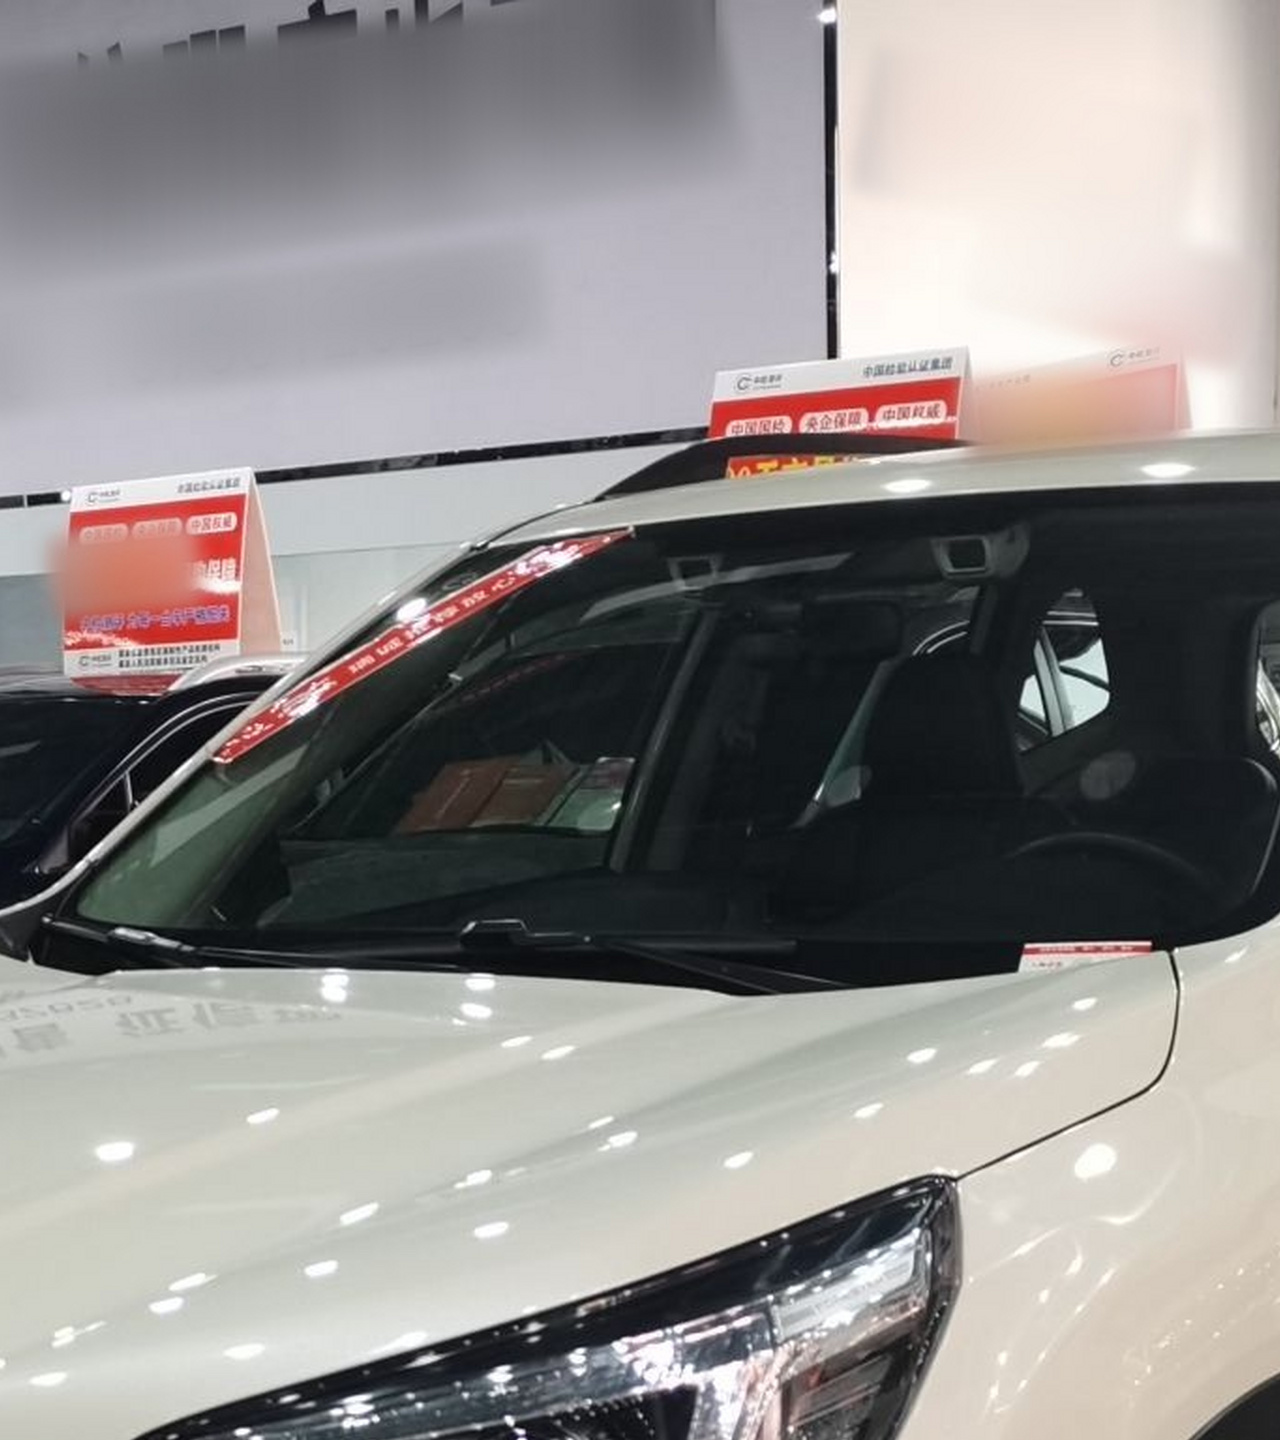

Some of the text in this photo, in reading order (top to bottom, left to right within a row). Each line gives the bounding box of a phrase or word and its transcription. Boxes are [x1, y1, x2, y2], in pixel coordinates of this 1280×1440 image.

[864, 357, 953, 377] 中国检验认证集团
[805, 413, 862, 433] 央企保障
[882, 402, 941, 421] 中国权威
